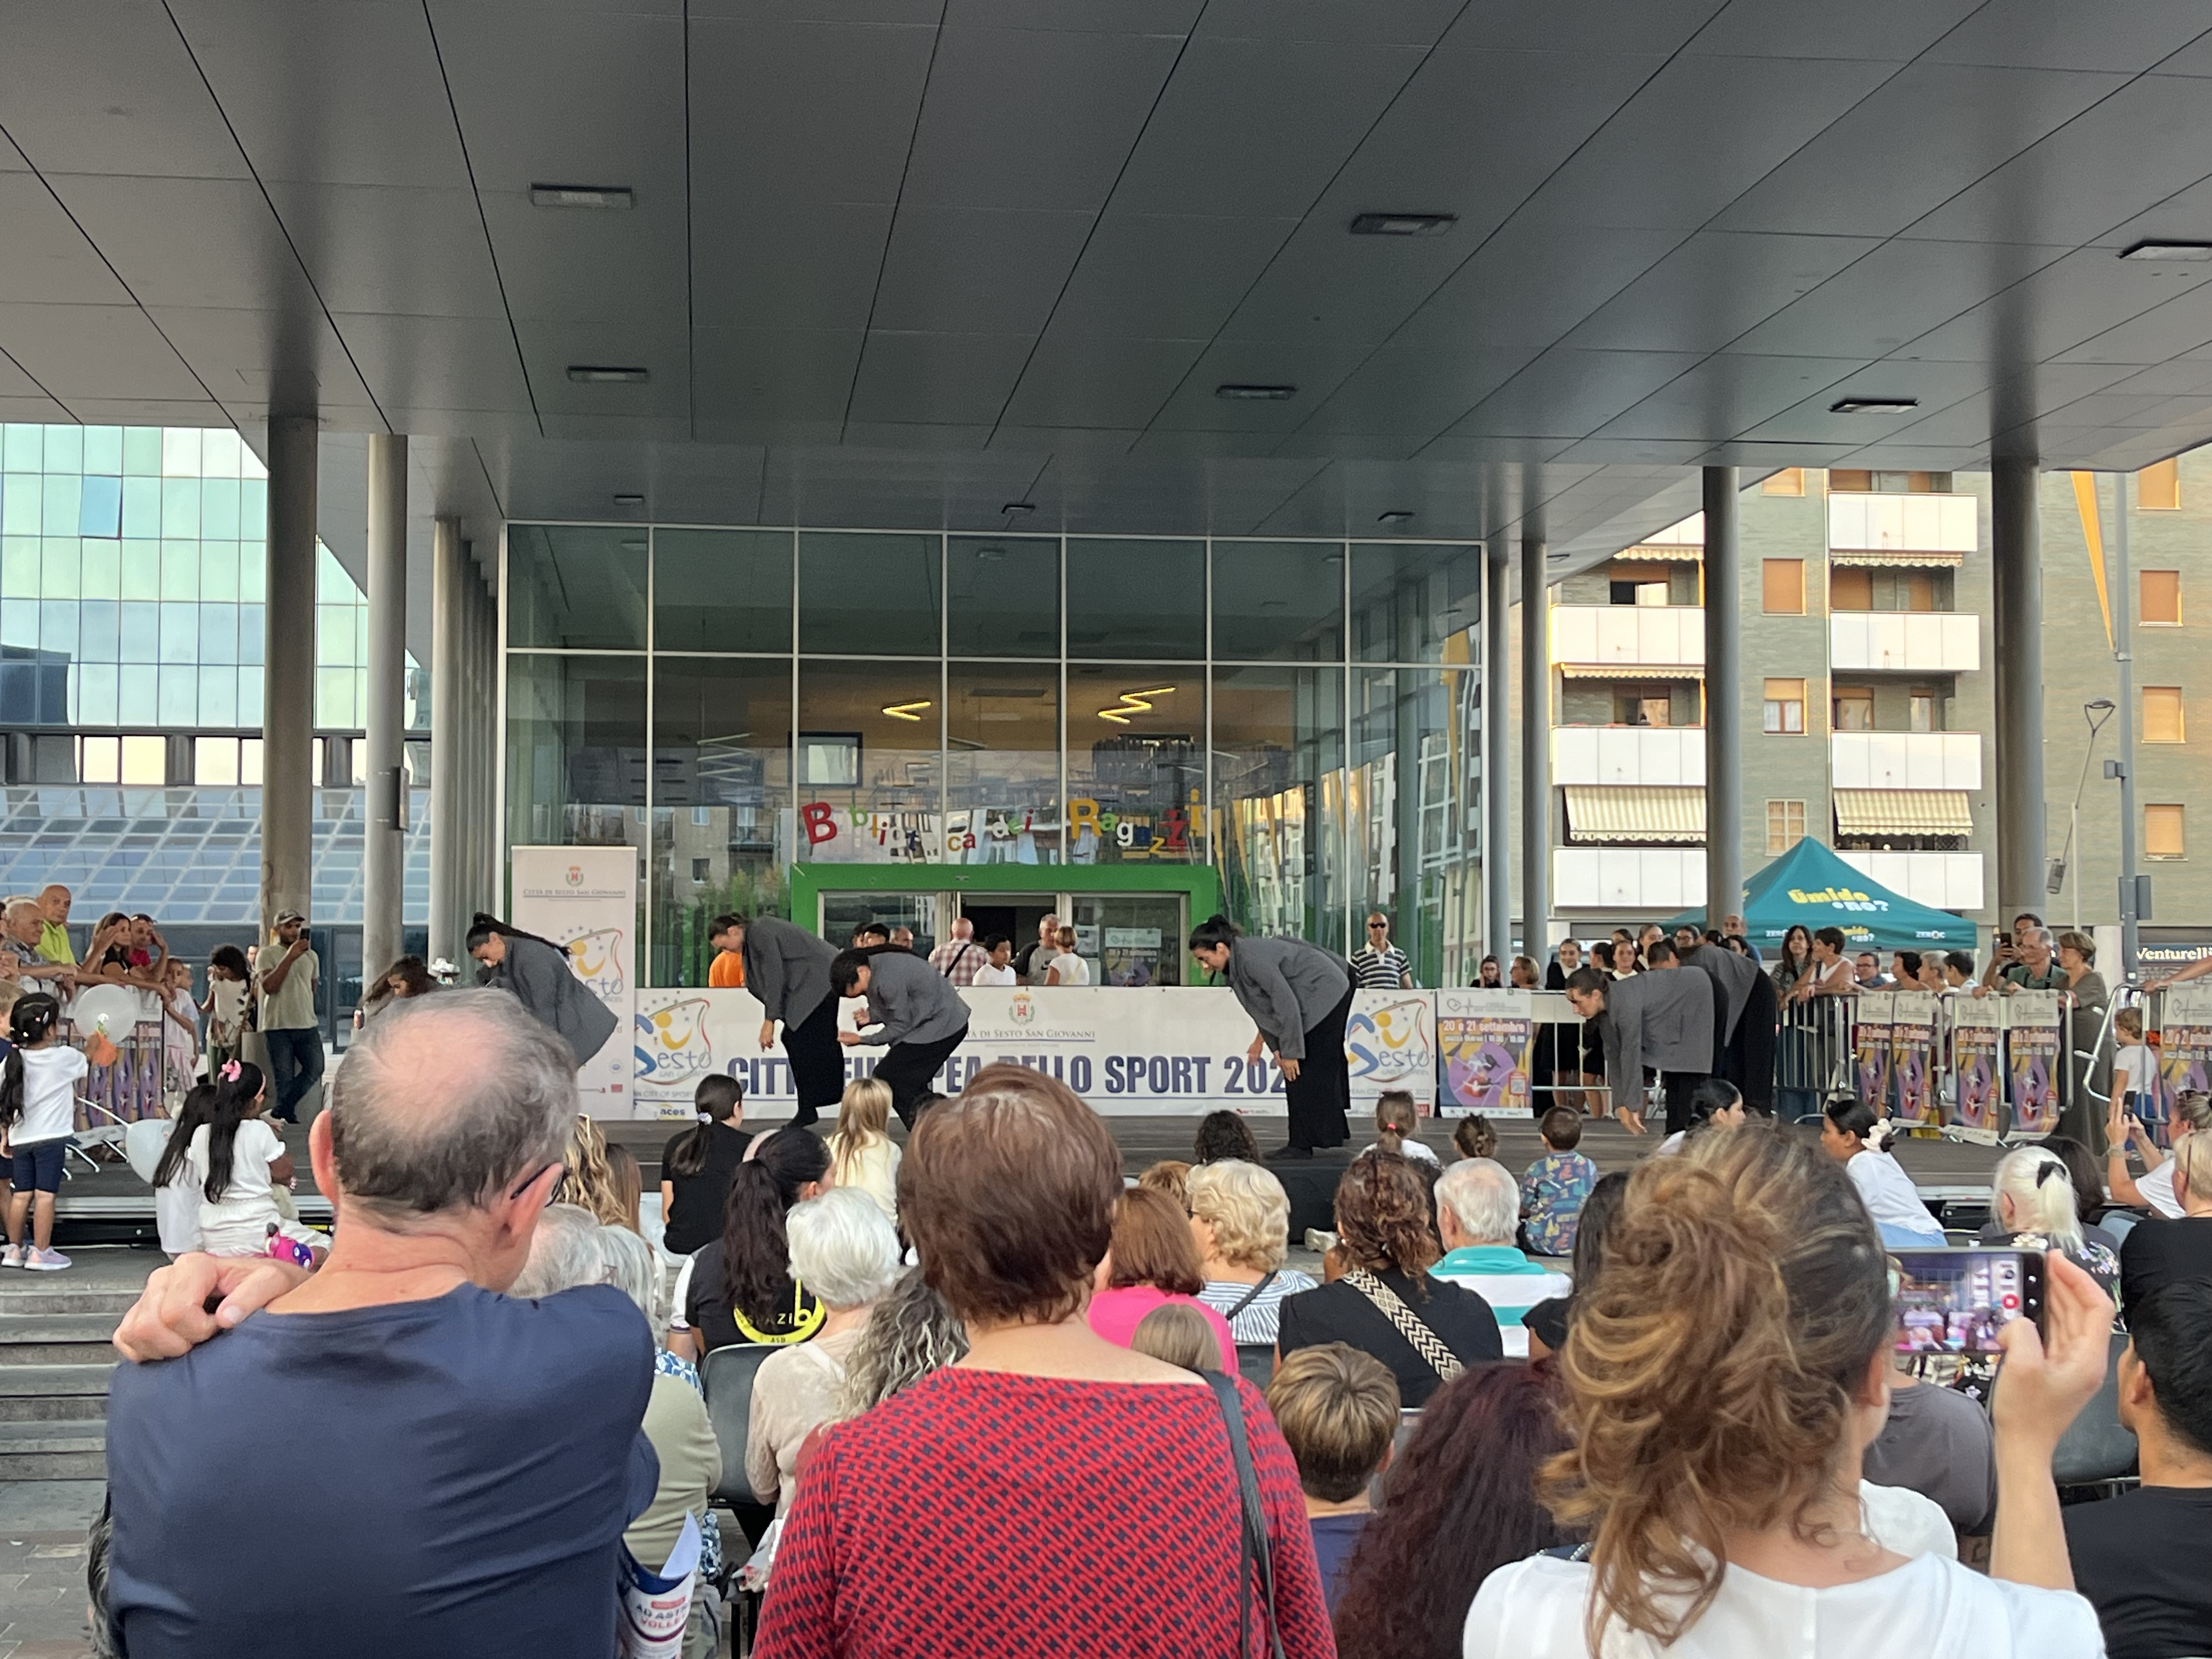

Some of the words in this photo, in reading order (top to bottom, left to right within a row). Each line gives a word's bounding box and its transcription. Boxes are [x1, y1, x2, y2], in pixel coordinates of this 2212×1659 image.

[801, 800, 977, 851] Bbliotca
[991, 808, 1034, 838] dei
[994, 1029, 1023, 1037] SESTO
[1025, 1029, 1044, 1037] SAN
[1443, 1019, 1455, 1031] 20
[1466, 1020, 1476, 1032] 21
[1479, 1022, 1526, 1033] settembre
[1105, 1056, 1211, 1093] SPORT
[1223, 1056, 1286, 1094] 202
